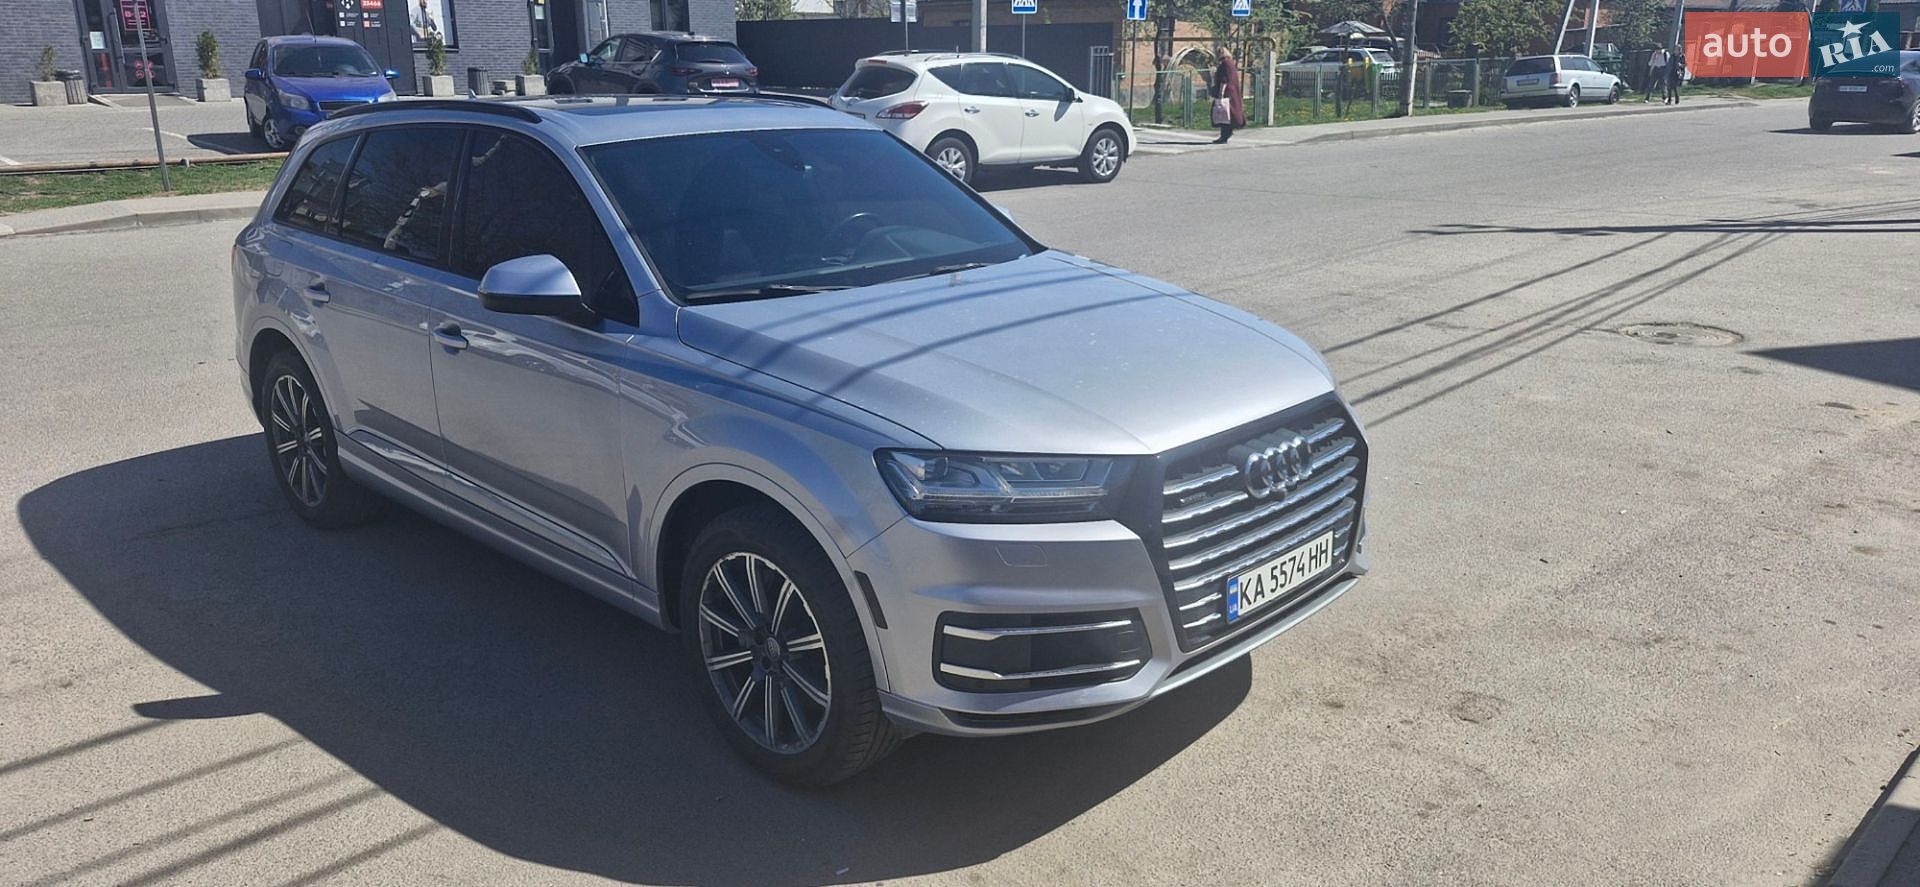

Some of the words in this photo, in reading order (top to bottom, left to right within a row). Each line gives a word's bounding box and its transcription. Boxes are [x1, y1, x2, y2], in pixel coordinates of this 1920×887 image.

[1240, 573, 1265, 609] KA
[1270, 551, 1305, 593] 5574
[1308, 538, 1329, 573] HH
